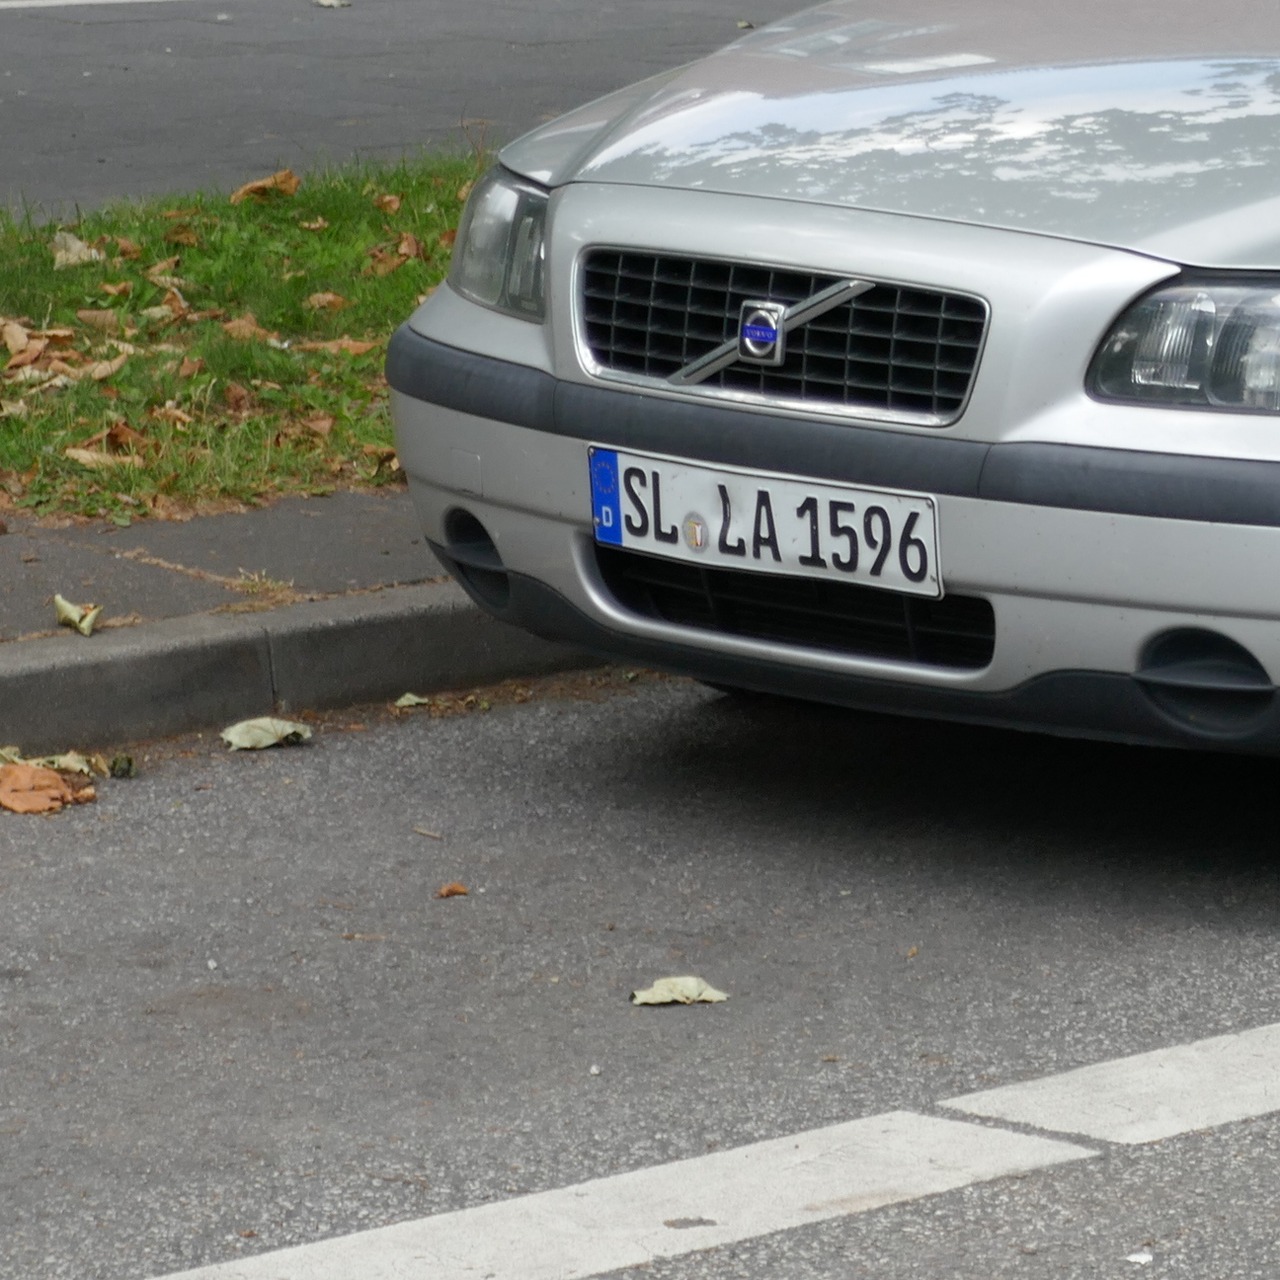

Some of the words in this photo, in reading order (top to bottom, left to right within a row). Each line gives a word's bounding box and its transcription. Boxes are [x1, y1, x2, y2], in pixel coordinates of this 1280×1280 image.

[602, 505, 613, 528] D
[622, 466, 680, 546] SL
[716, 483, 783, 563] LA
[795, 495, 929, 584] 1596
